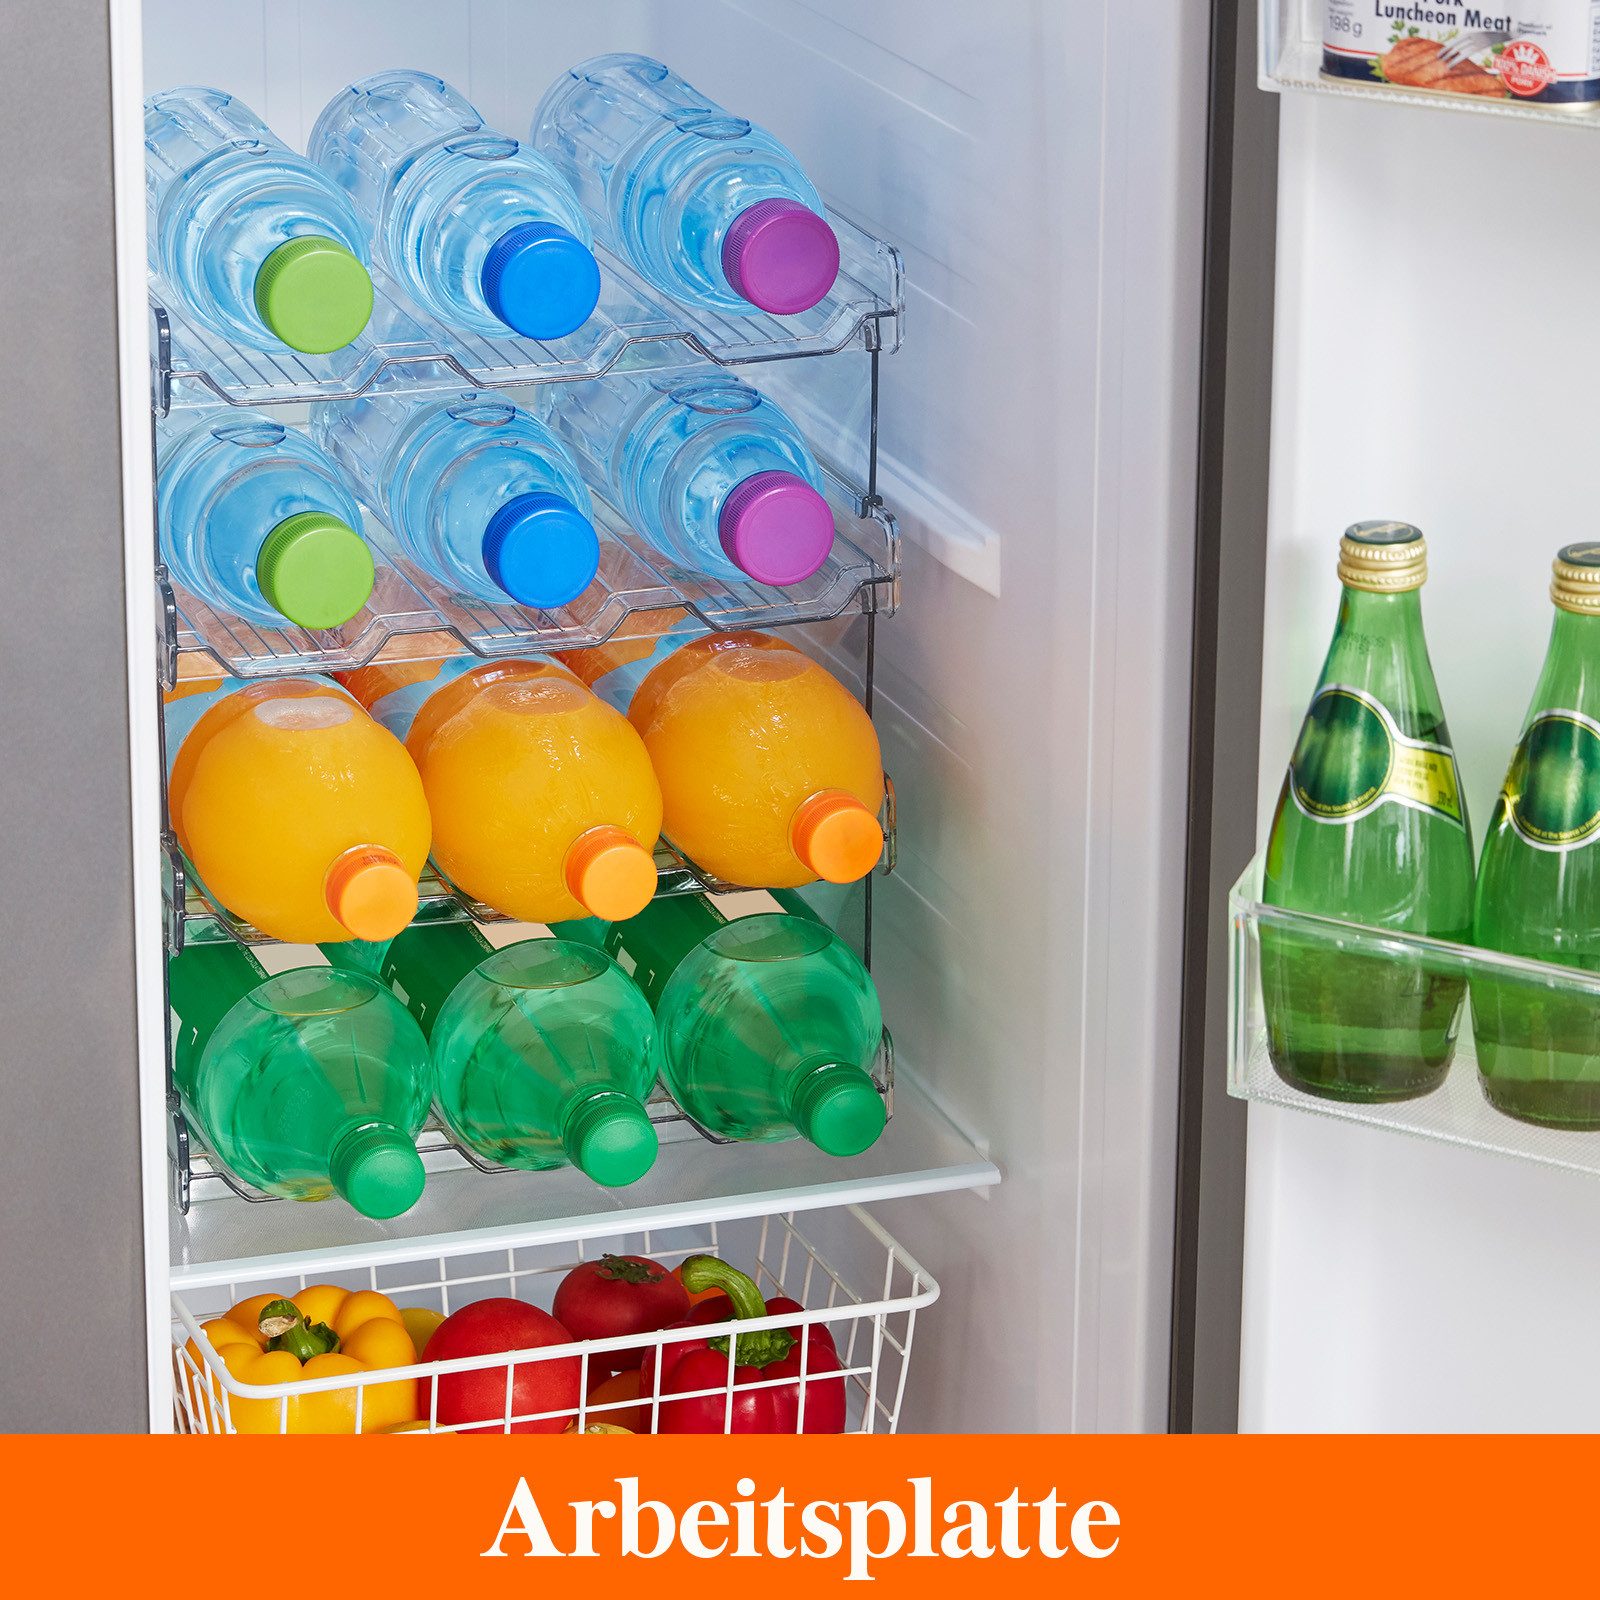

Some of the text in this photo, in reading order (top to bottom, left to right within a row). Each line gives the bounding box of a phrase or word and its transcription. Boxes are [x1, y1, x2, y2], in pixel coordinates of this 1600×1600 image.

[1329, 15, 1351, 32] 198
[1375, 0, 1512, 32] Luncheon Meat
